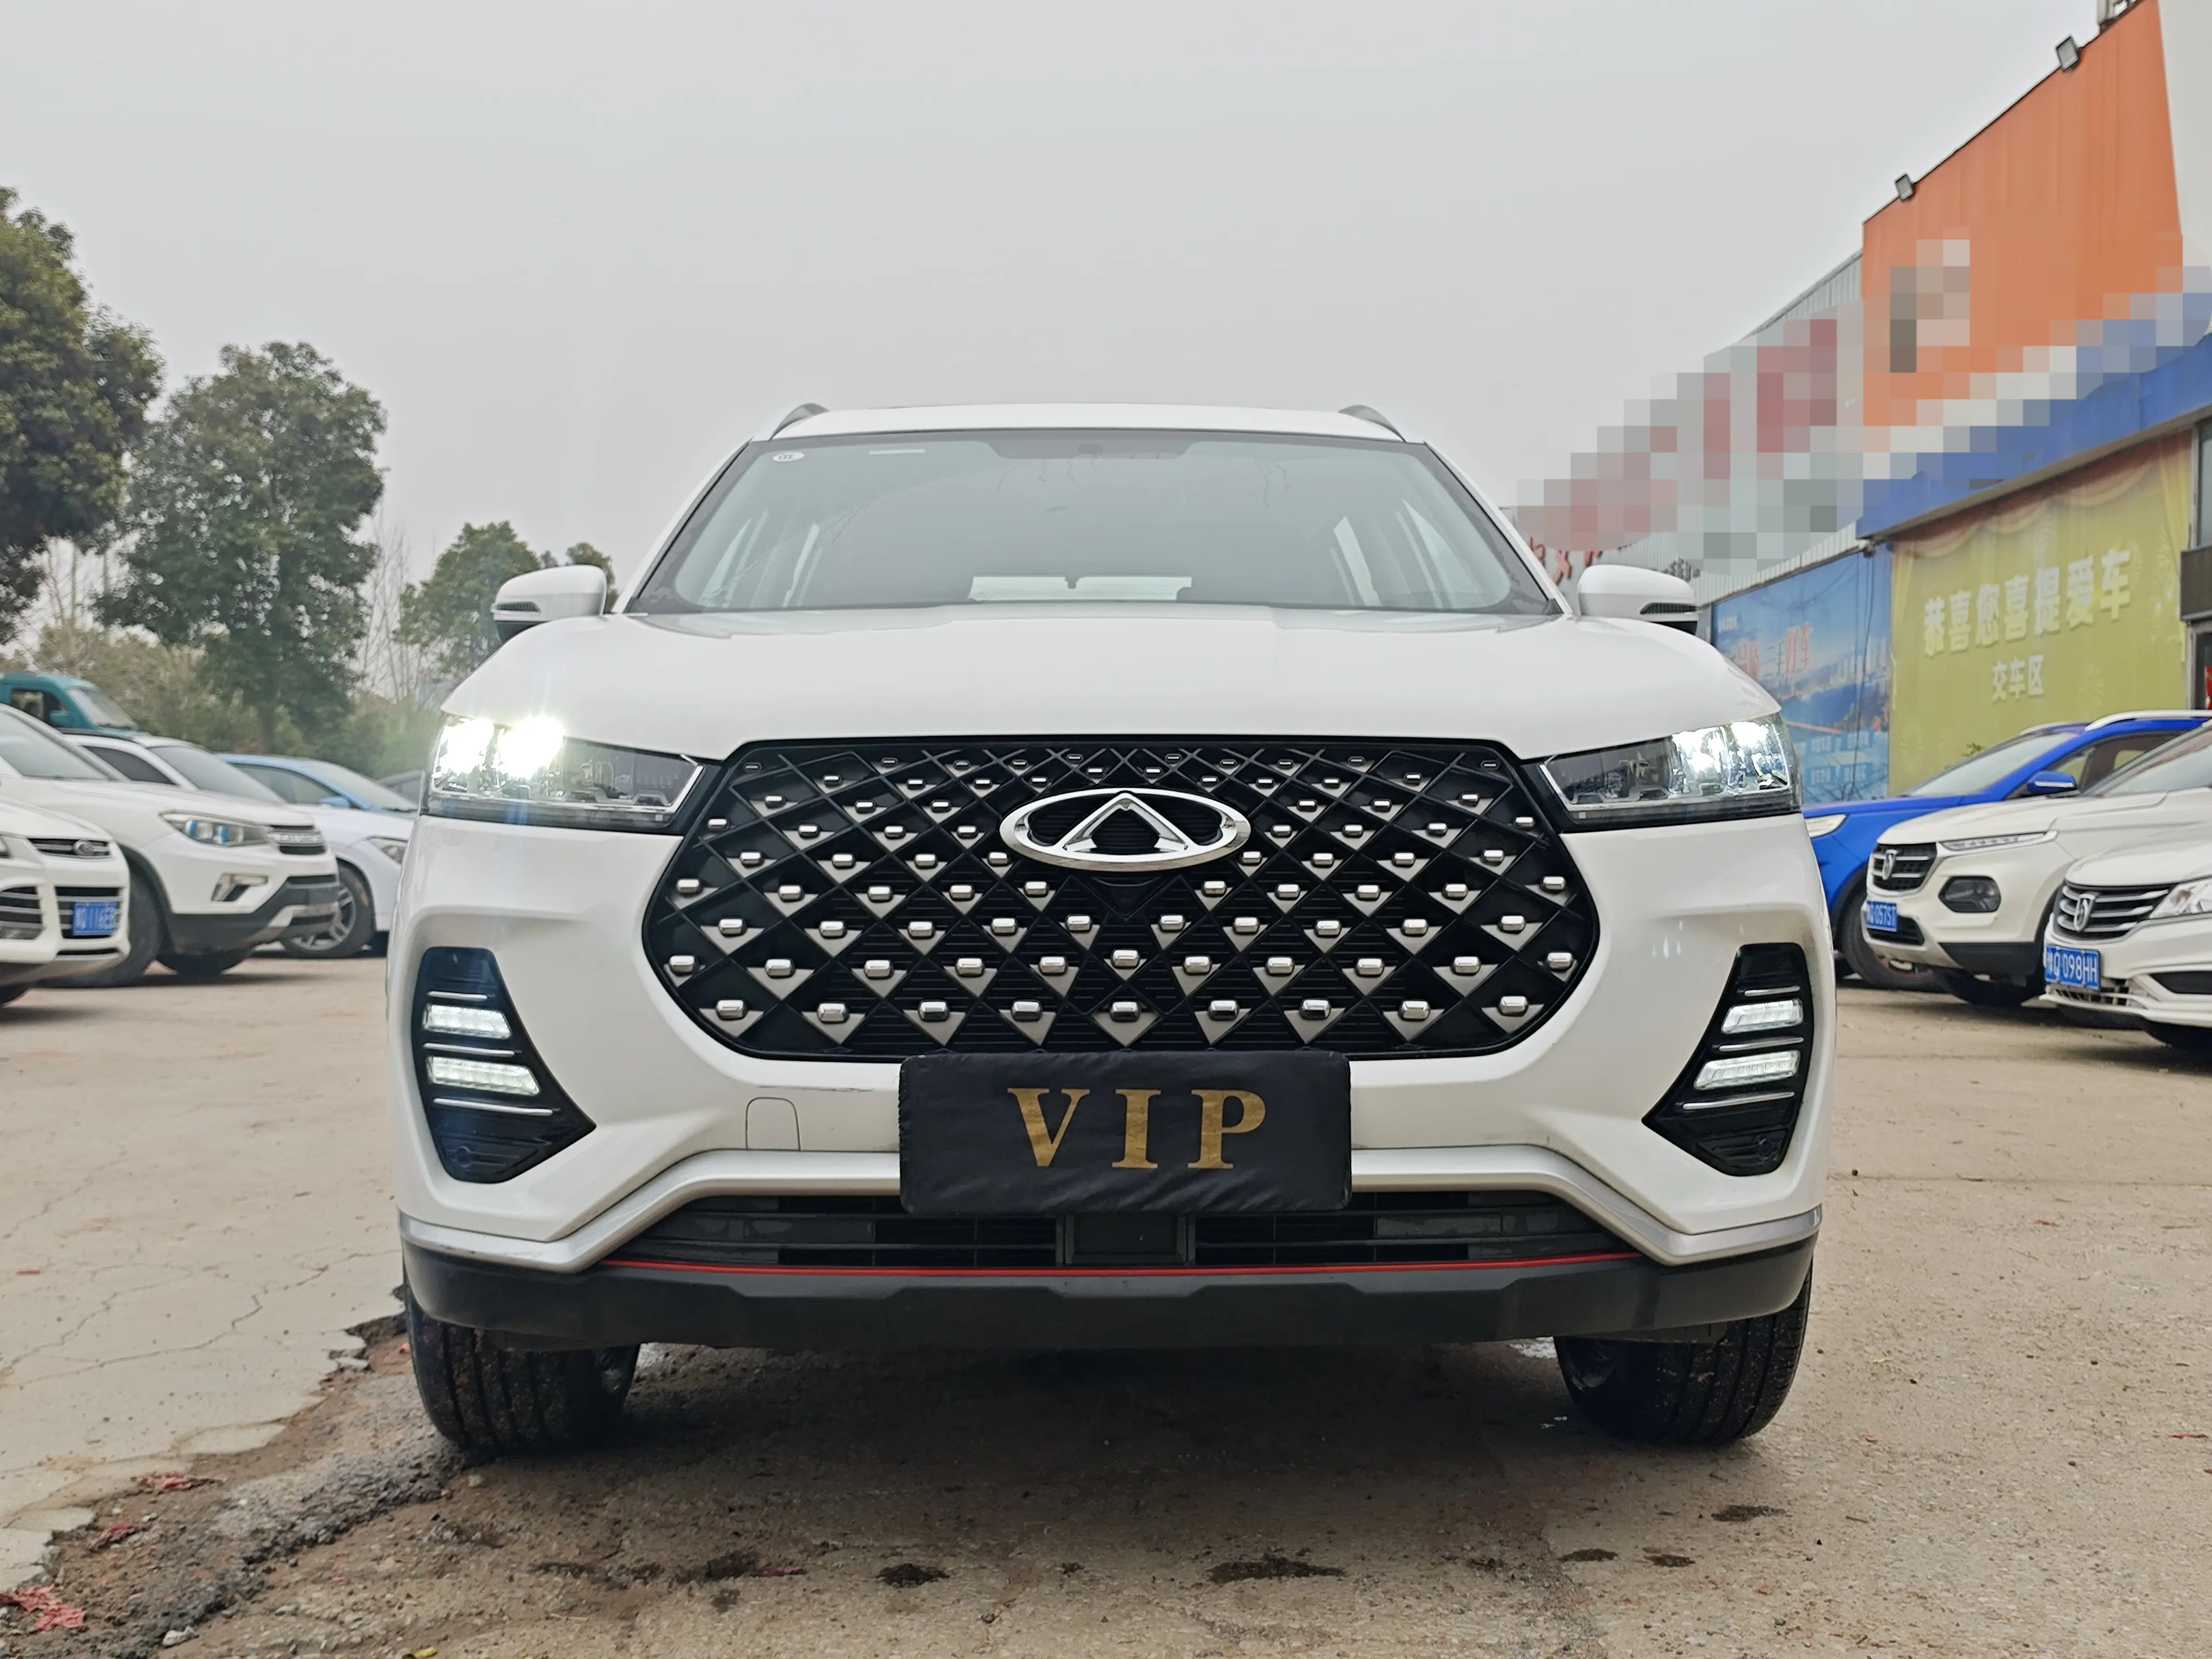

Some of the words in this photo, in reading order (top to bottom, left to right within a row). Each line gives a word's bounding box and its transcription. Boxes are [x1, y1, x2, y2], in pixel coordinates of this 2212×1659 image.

[1992, 653, 2044, 703] 交车区
[1007, 1087, 1266, 1170] VIP
